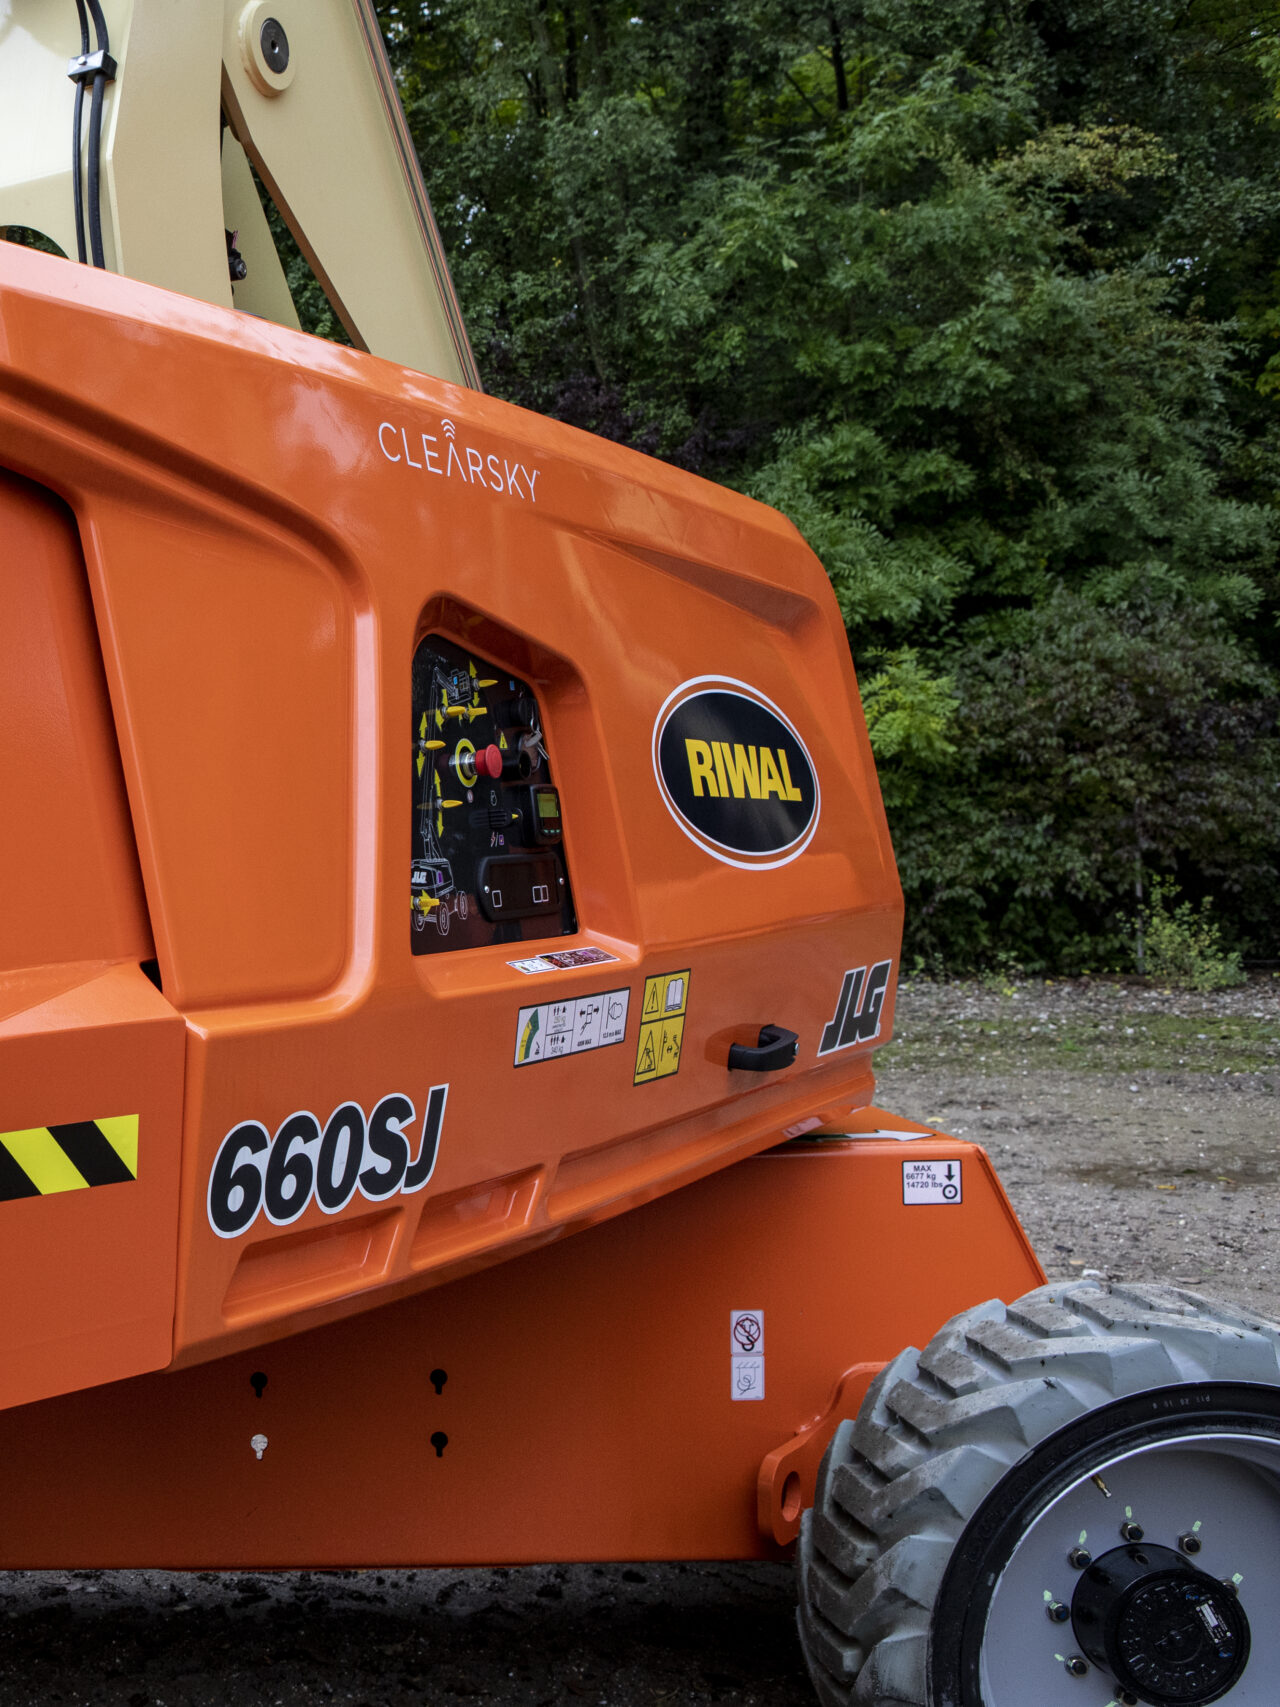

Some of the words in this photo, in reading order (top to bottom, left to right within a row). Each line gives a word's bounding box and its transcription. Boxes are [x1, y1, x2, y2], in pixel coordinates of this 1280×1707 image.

[378, 421, 537, 503] CLEARSKY
[684, 738, 803, 802] RIWAL
[817, 959, 892, 1057] JLG
[207, 1083, 449, 1239] 660SJ
[913, 1164, 932, 1172] MAX
[926, 1172, 937, 1181] kg
